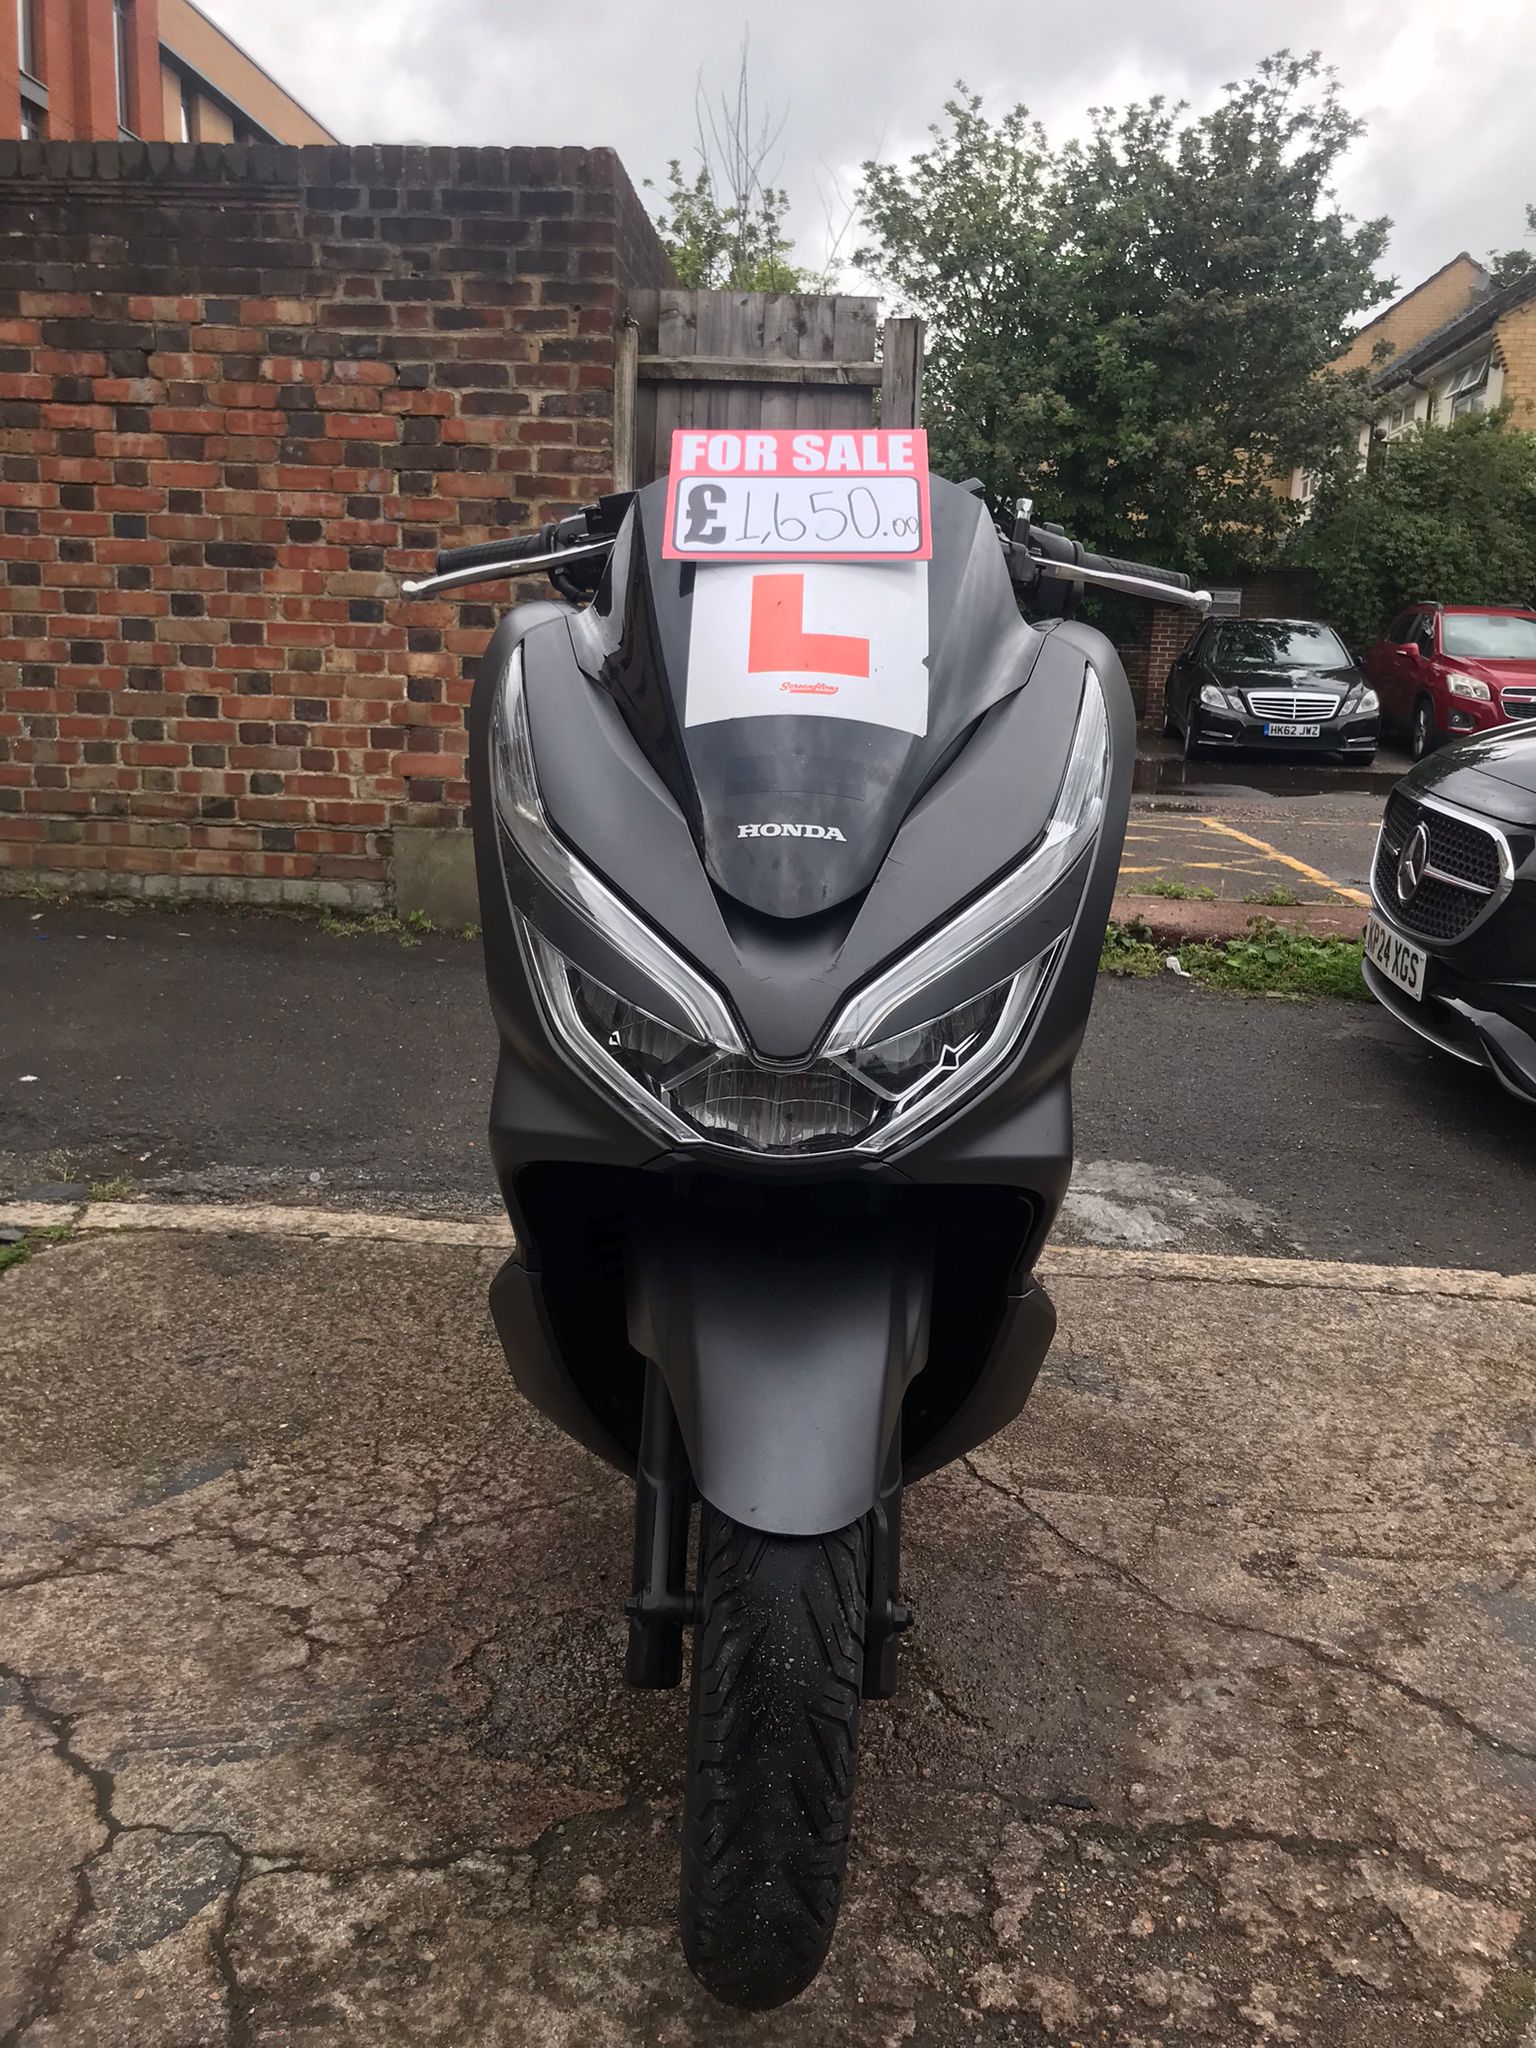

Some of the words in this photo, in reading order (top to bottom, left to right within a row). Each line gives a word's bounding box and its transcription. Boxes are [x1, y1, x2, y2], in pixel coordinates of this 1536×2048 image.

[680, 434, 777, 471] FOR
[792, 434, 914, 472] SALE
[748, 574, 870, 678] L
[1270, 725, 1297, 736] HK62
[1299, 726, 1319, 736] JWZ
[737, 823, 848, 842] HONDA
[1391, 939, 1419, 988] XGS
